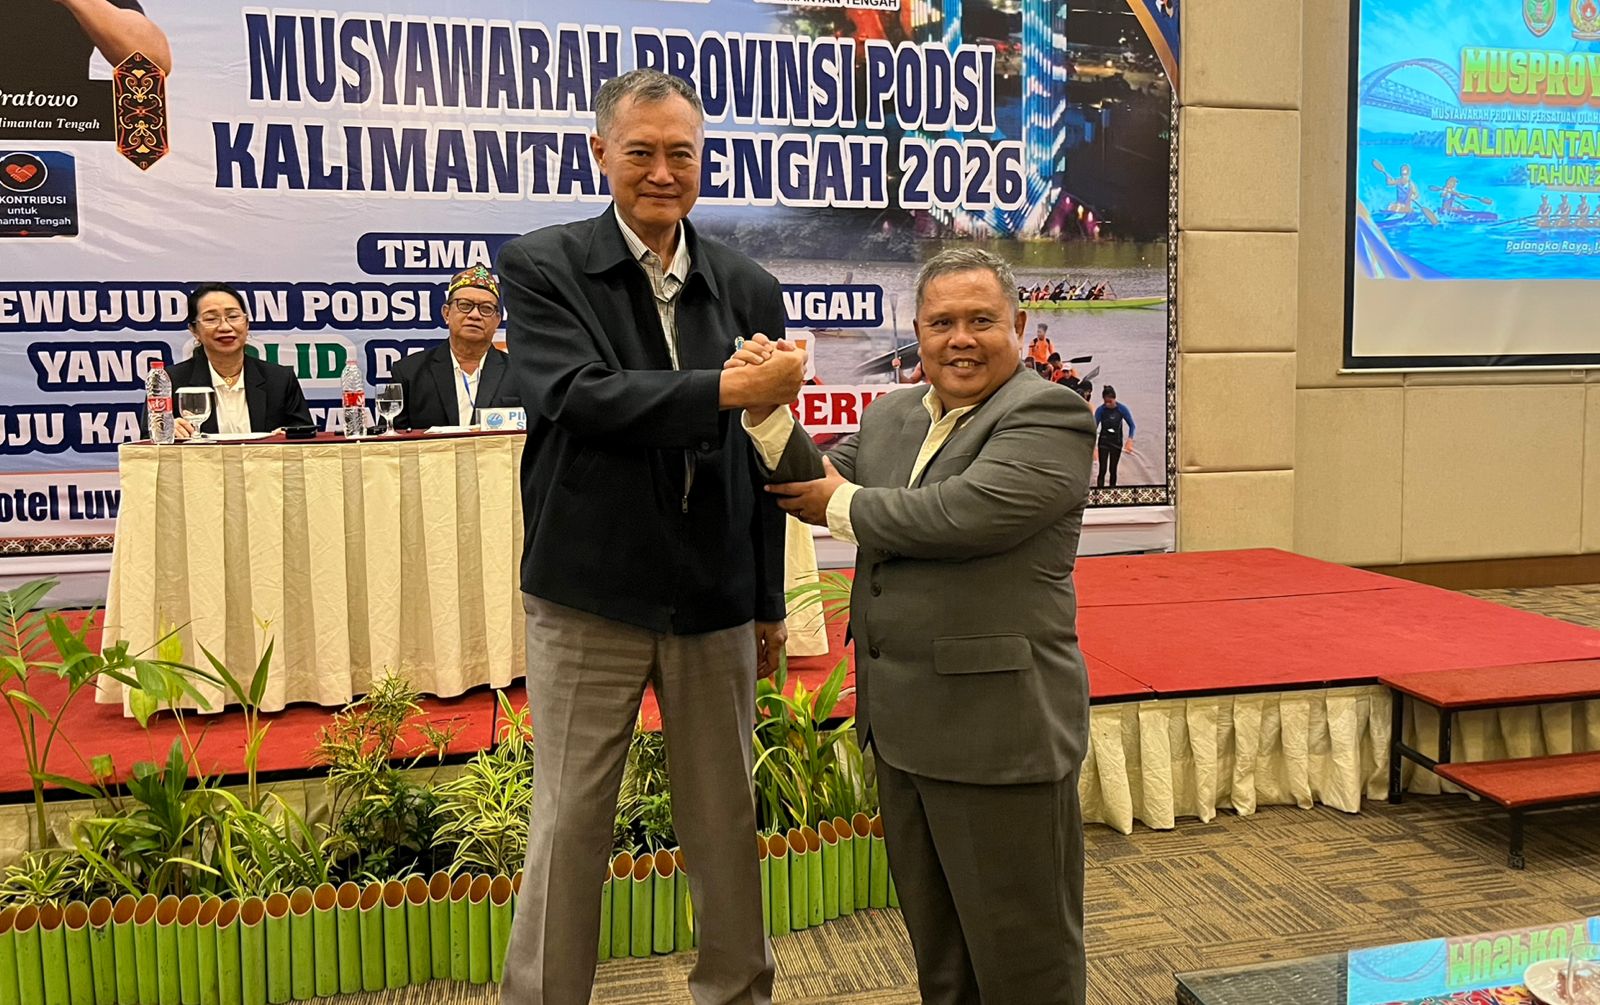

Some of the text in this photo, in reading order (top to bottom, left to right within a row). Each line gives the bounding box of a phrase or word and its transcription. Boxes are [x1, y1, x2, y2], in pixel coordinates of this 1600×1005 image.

[244, 14, 619, 112] MUSYAWARAH
[866, 44, 994, 127] PODSI
[0, 89, 78, 108] ratowo
[56, 118, 100, 132] Tengah
[1431, 107, 1489, 121] MUSYAWARAH
[1490, 109, 1530, 123] PROVINSI
[1531, 110, 1576, 124] PERSATUAN
[212, 122, 1023, 204] KALIMANTA ENGAH 2026
[1527, 164, 1590, 186] TAHUN
[7, 206, 38, 215] untuk
[34, 216, 71, 227] Tengah
[377, 239, 492, 269] TEMA
[1506, 240, 1559, 253] Palangka
[302, 290, 433, 322] PODSI
